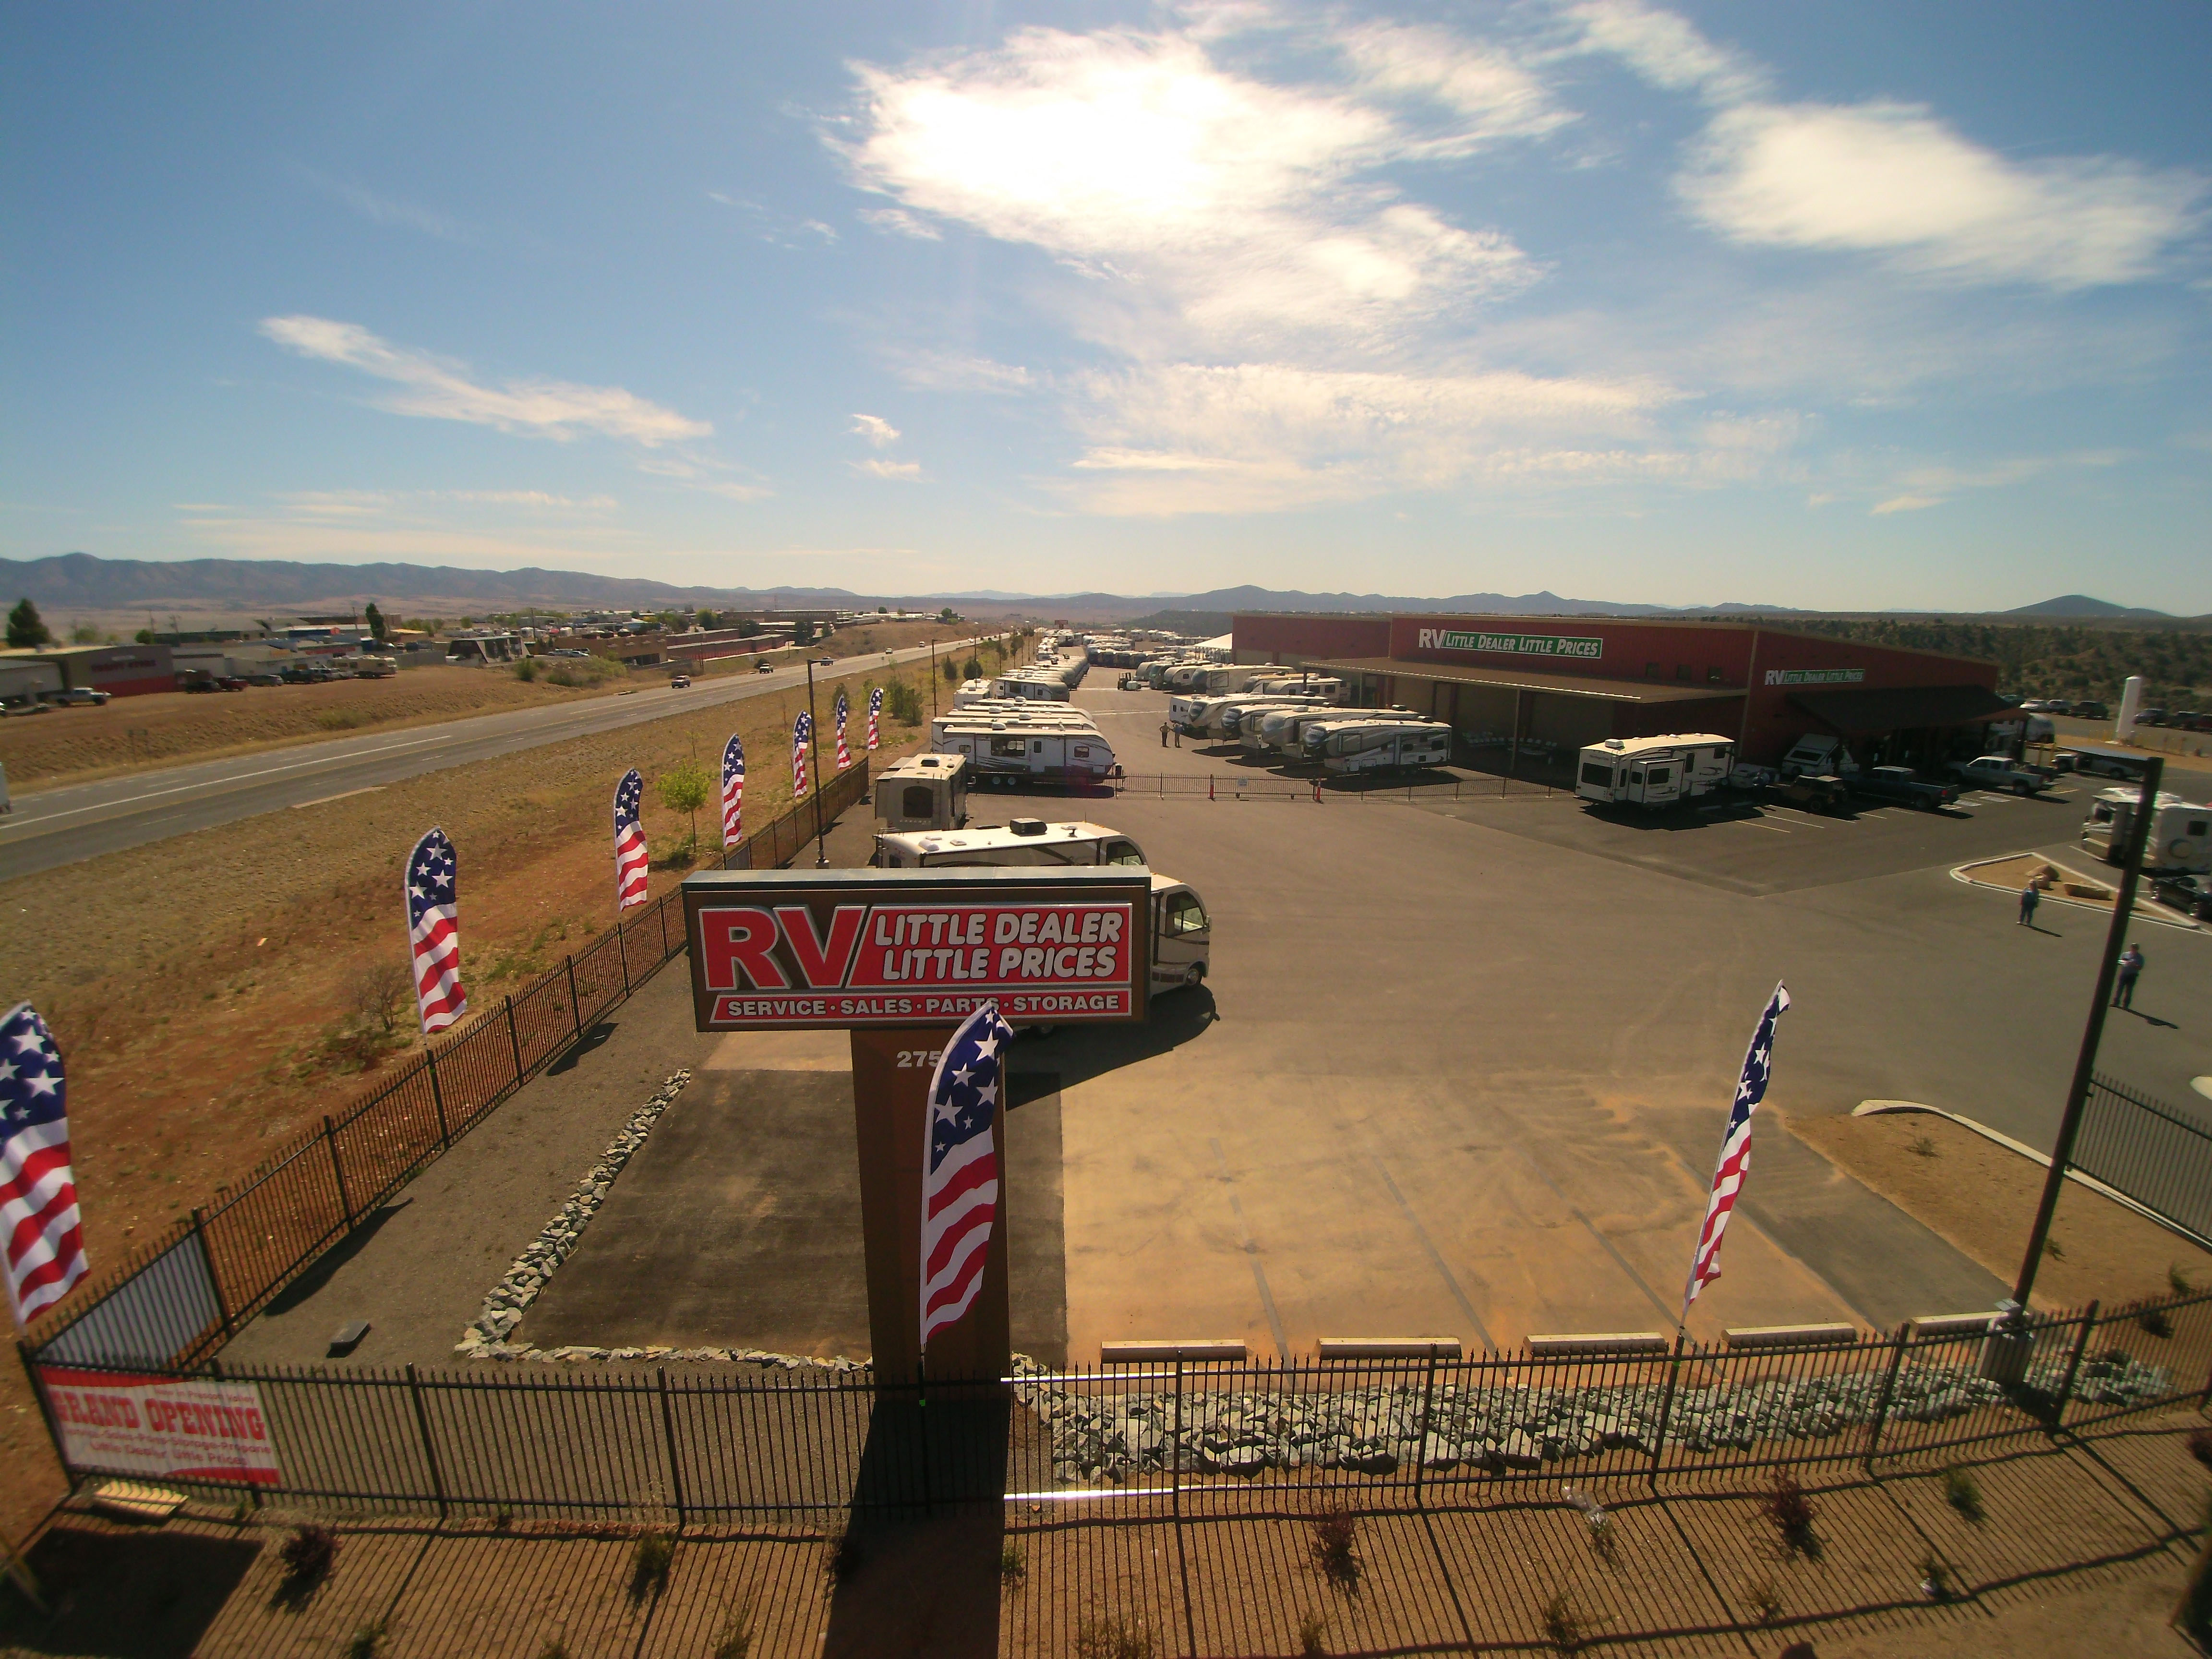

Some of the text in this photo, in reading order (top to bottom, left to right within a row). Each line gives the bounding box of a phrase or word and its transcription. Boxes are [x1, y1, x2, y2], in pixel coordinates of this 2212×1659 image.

[1419, 628, 1598, 656] RV LITTLE DEALER LITTLE PRICES
[1765, 670, 1785, 685] RV
[875, 912, 1123, 946] LITTLE DEALER
[698, 904, 867, 991] RV
[883, 947, 1117, 980] LITTLE PRICES
[729, 1000, 826, 1016] SERVICE
[841, 998, 912, 1015] SALES
[1013, 995, 1119, 1012] STORAGE
[145, 1398, 266, 1440] OPENING
